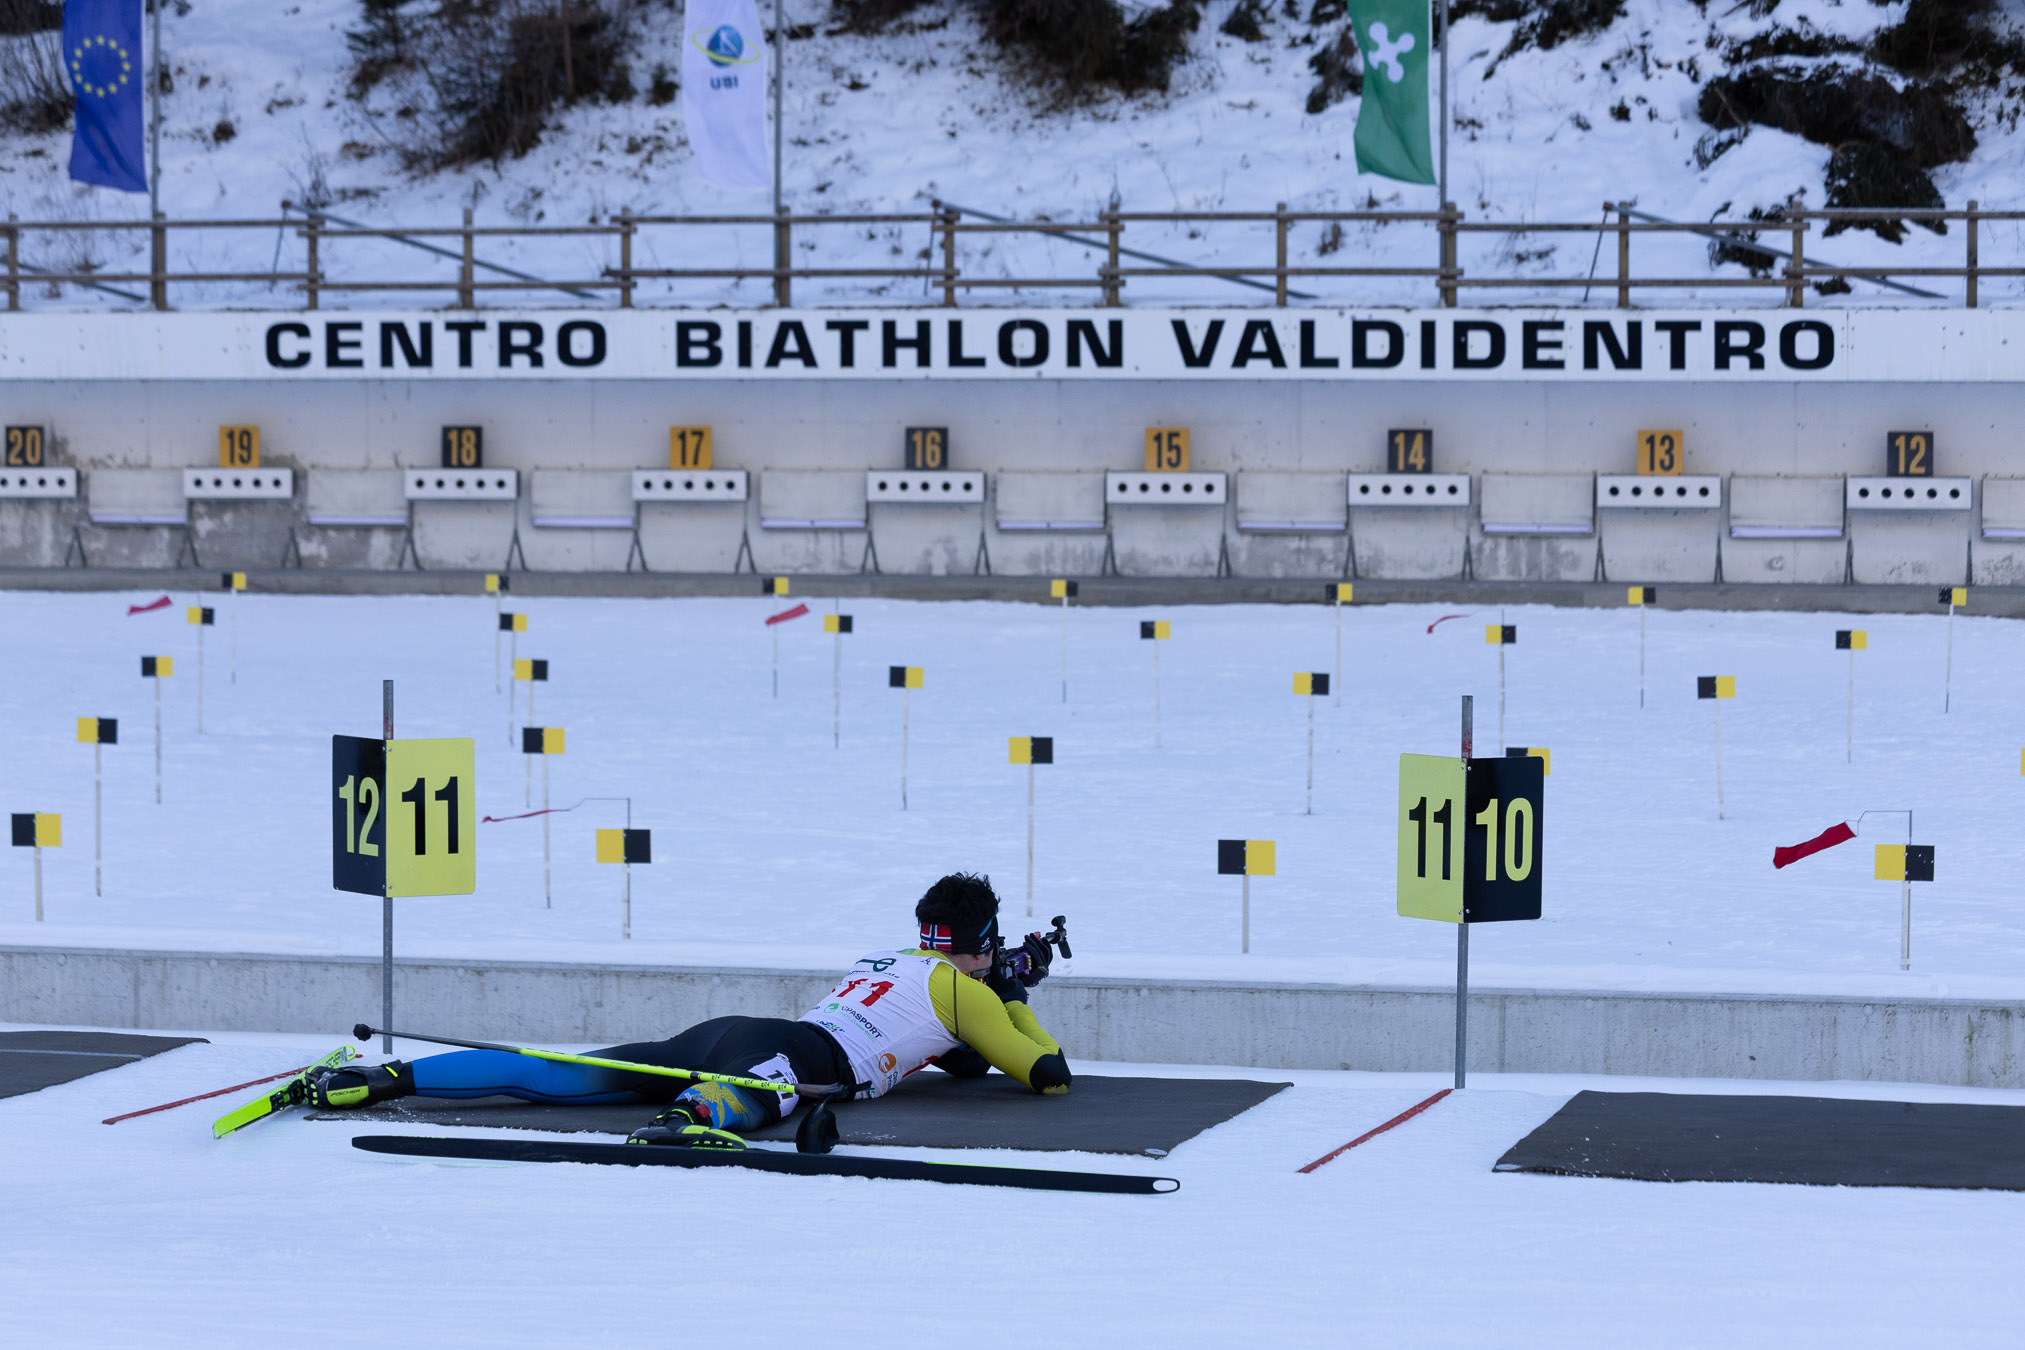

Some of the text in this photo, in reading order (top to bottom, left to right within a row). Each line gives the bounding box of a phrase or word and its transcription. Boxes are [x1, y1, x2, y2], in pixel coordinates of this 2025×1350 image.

[265, 319, 1835, 370] CENTRO BIATHLON VALDIDENTRO
[8, 428, 41, 465] 20
[226, 428, 252, 465] 19
[447, 428, 477, 466] 18
[677, 430, 704, 466] 17
[911, 430, 942, 468] 16
[1153, 431, 1181, 469] 15
[1394, 432, 1426, 471] 14
[1645, 433, 1675, 472] 13
[1895, 434, 1926, 474] 12
[338, 775, 379, 857] 12
[401, 776, 459, 855] 11
[1408, 796, 1452, 880] 11
[1475, 797, 1533, 882] 10
